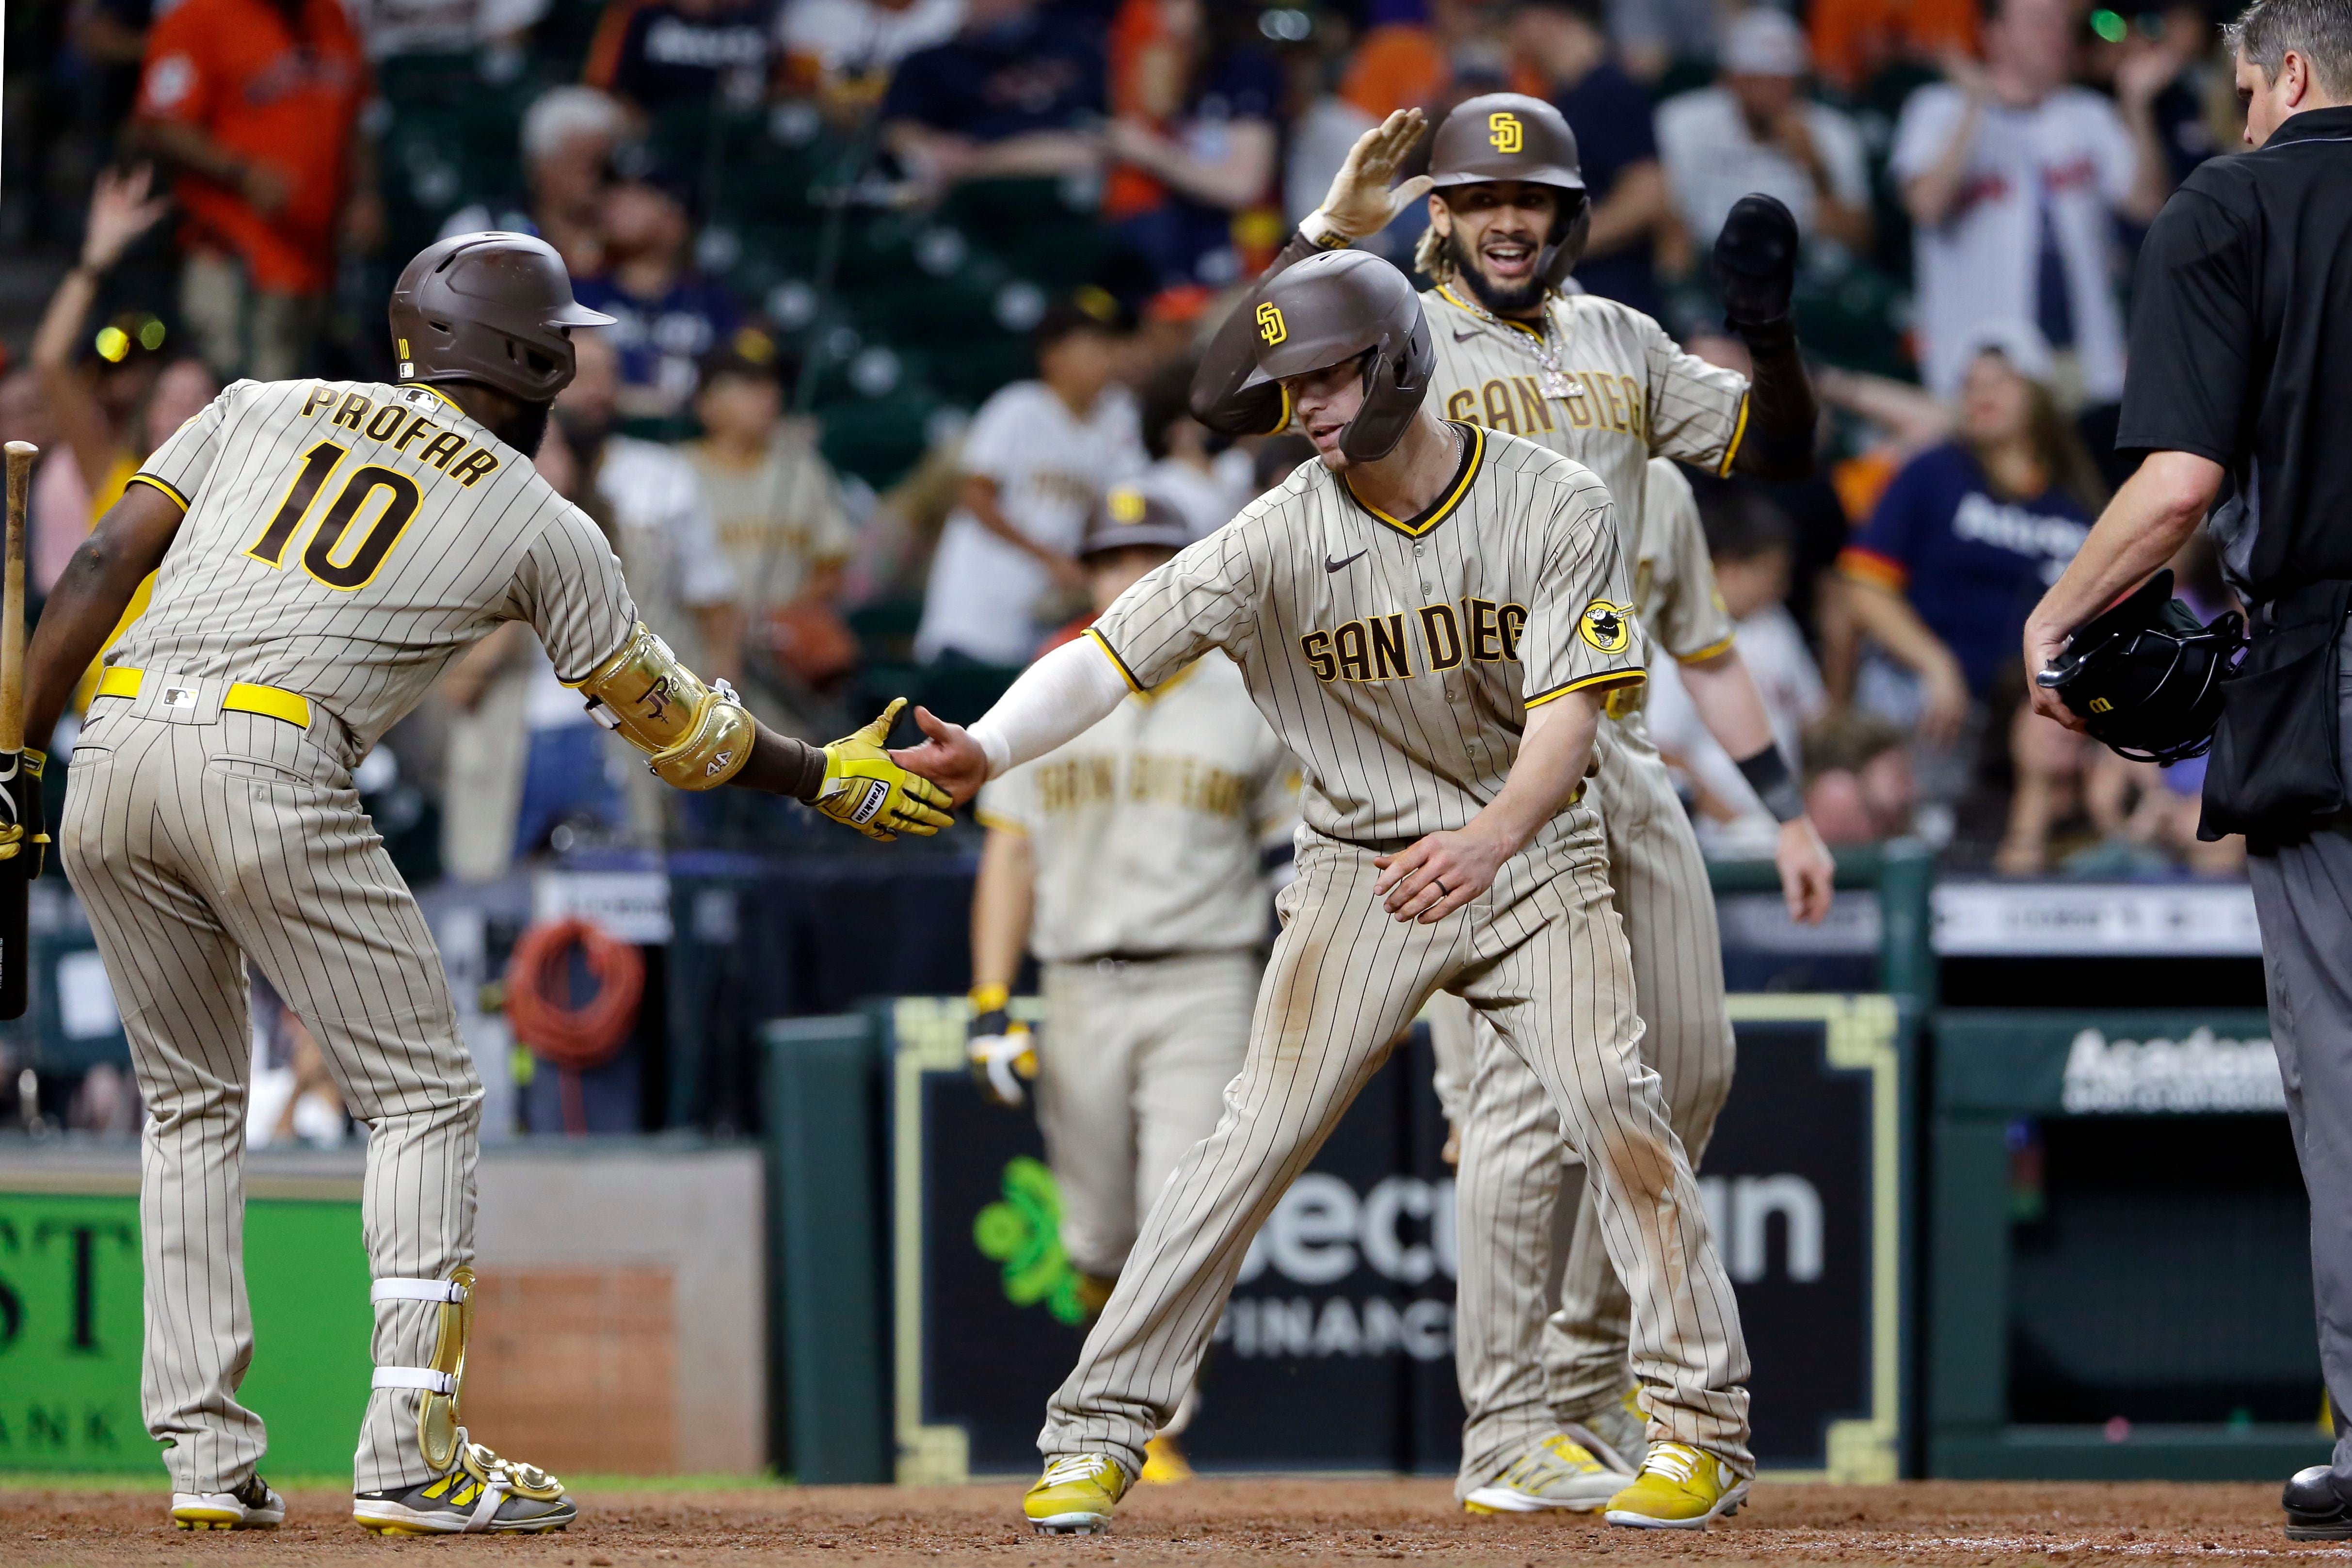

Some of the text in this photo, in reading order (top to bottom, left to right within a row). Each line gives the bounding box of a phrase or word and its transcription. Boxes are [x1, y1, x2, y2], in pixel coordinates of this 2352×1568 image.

[398, 338, 410, 359] 10
[300, 386, 500, 489] PROFAR
[1447, 375, 1556, 436] SAN
[241, 439, 424, 592] 10
[1298, 612, 1416, 683] SAN
